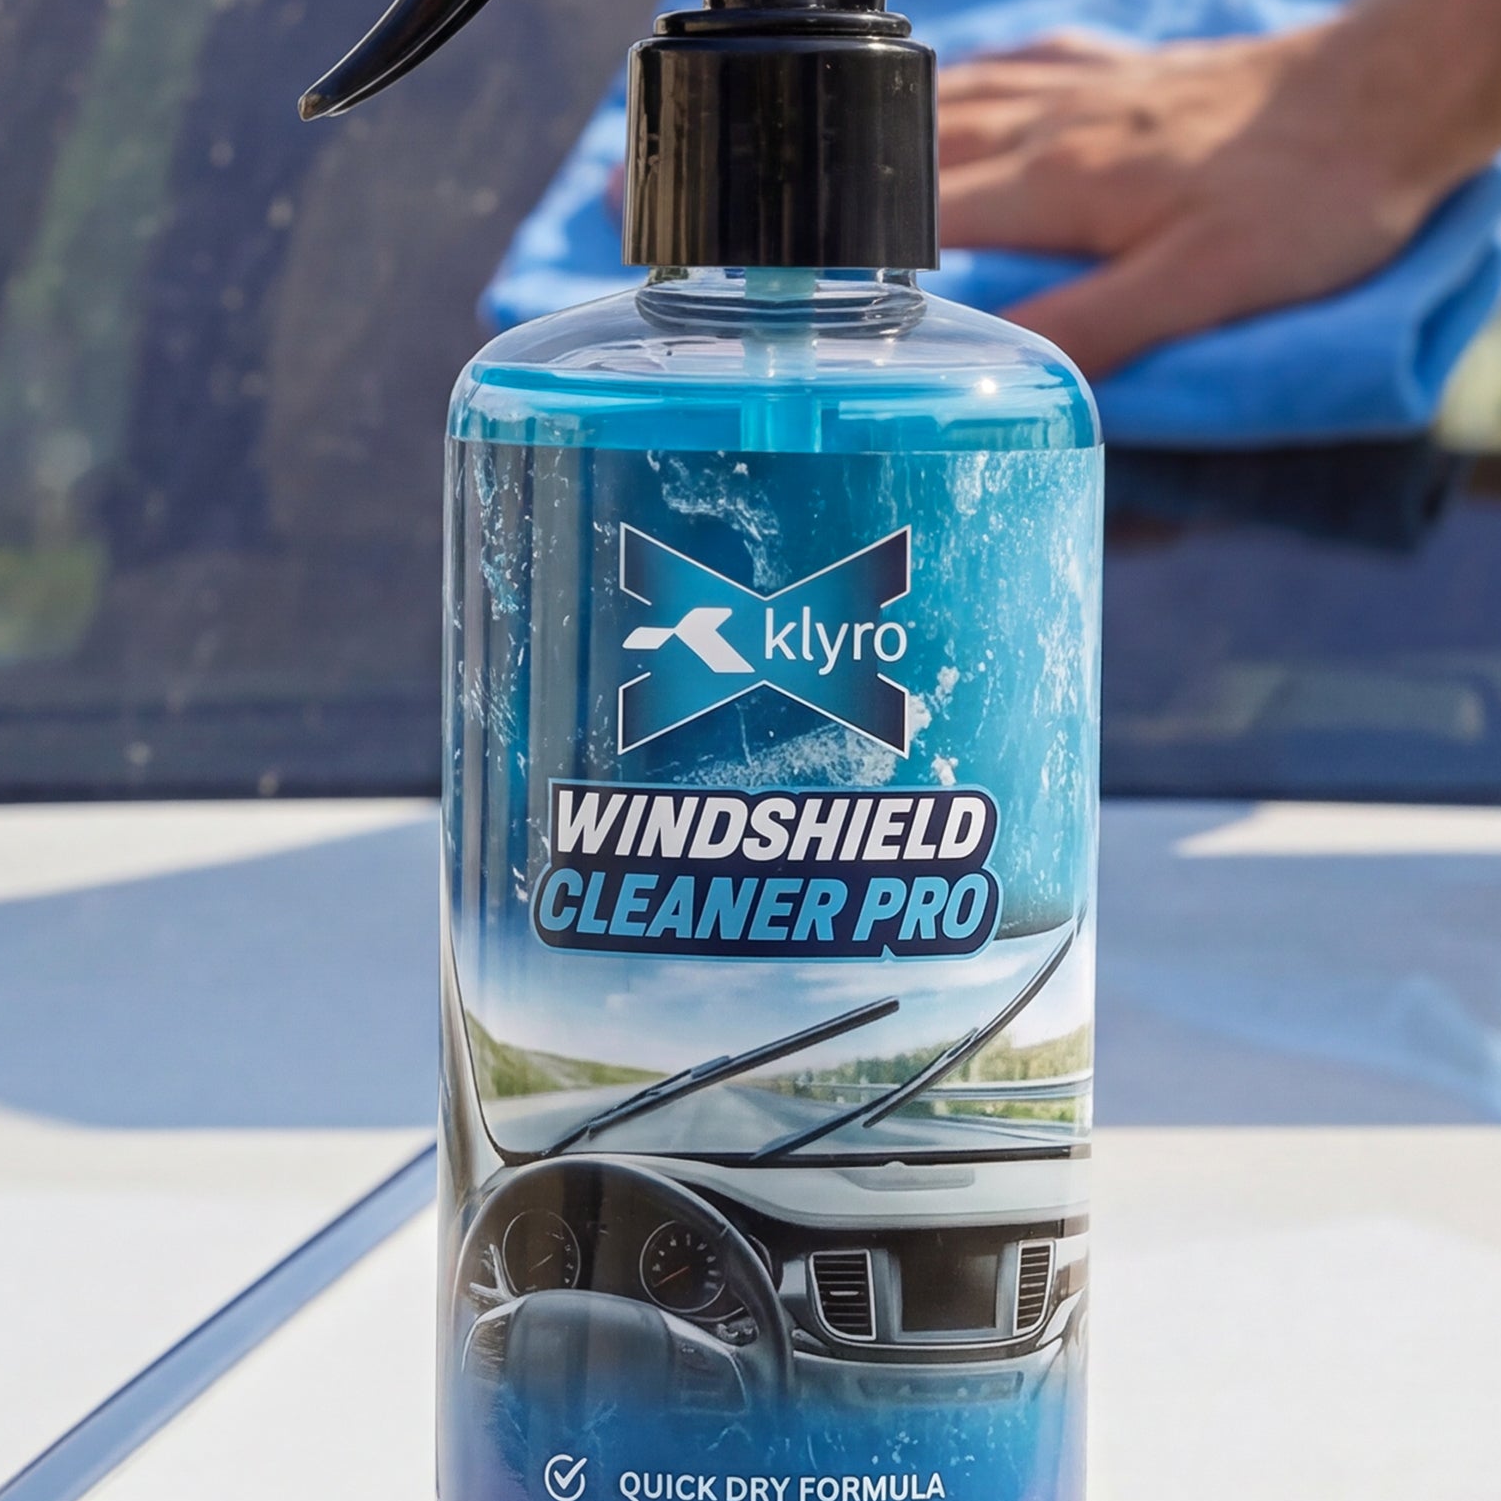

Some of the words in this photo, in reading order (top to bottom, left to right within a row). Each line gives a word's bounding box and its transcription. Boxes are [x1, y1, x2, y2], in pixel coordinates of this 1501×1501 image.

[764, 605, 908, 676] klyro
[556, 788, 990, 863] WINDSHIELD
[536, 866, 844, 942] CLEANER
[851, 875, 990, 942] PRO
